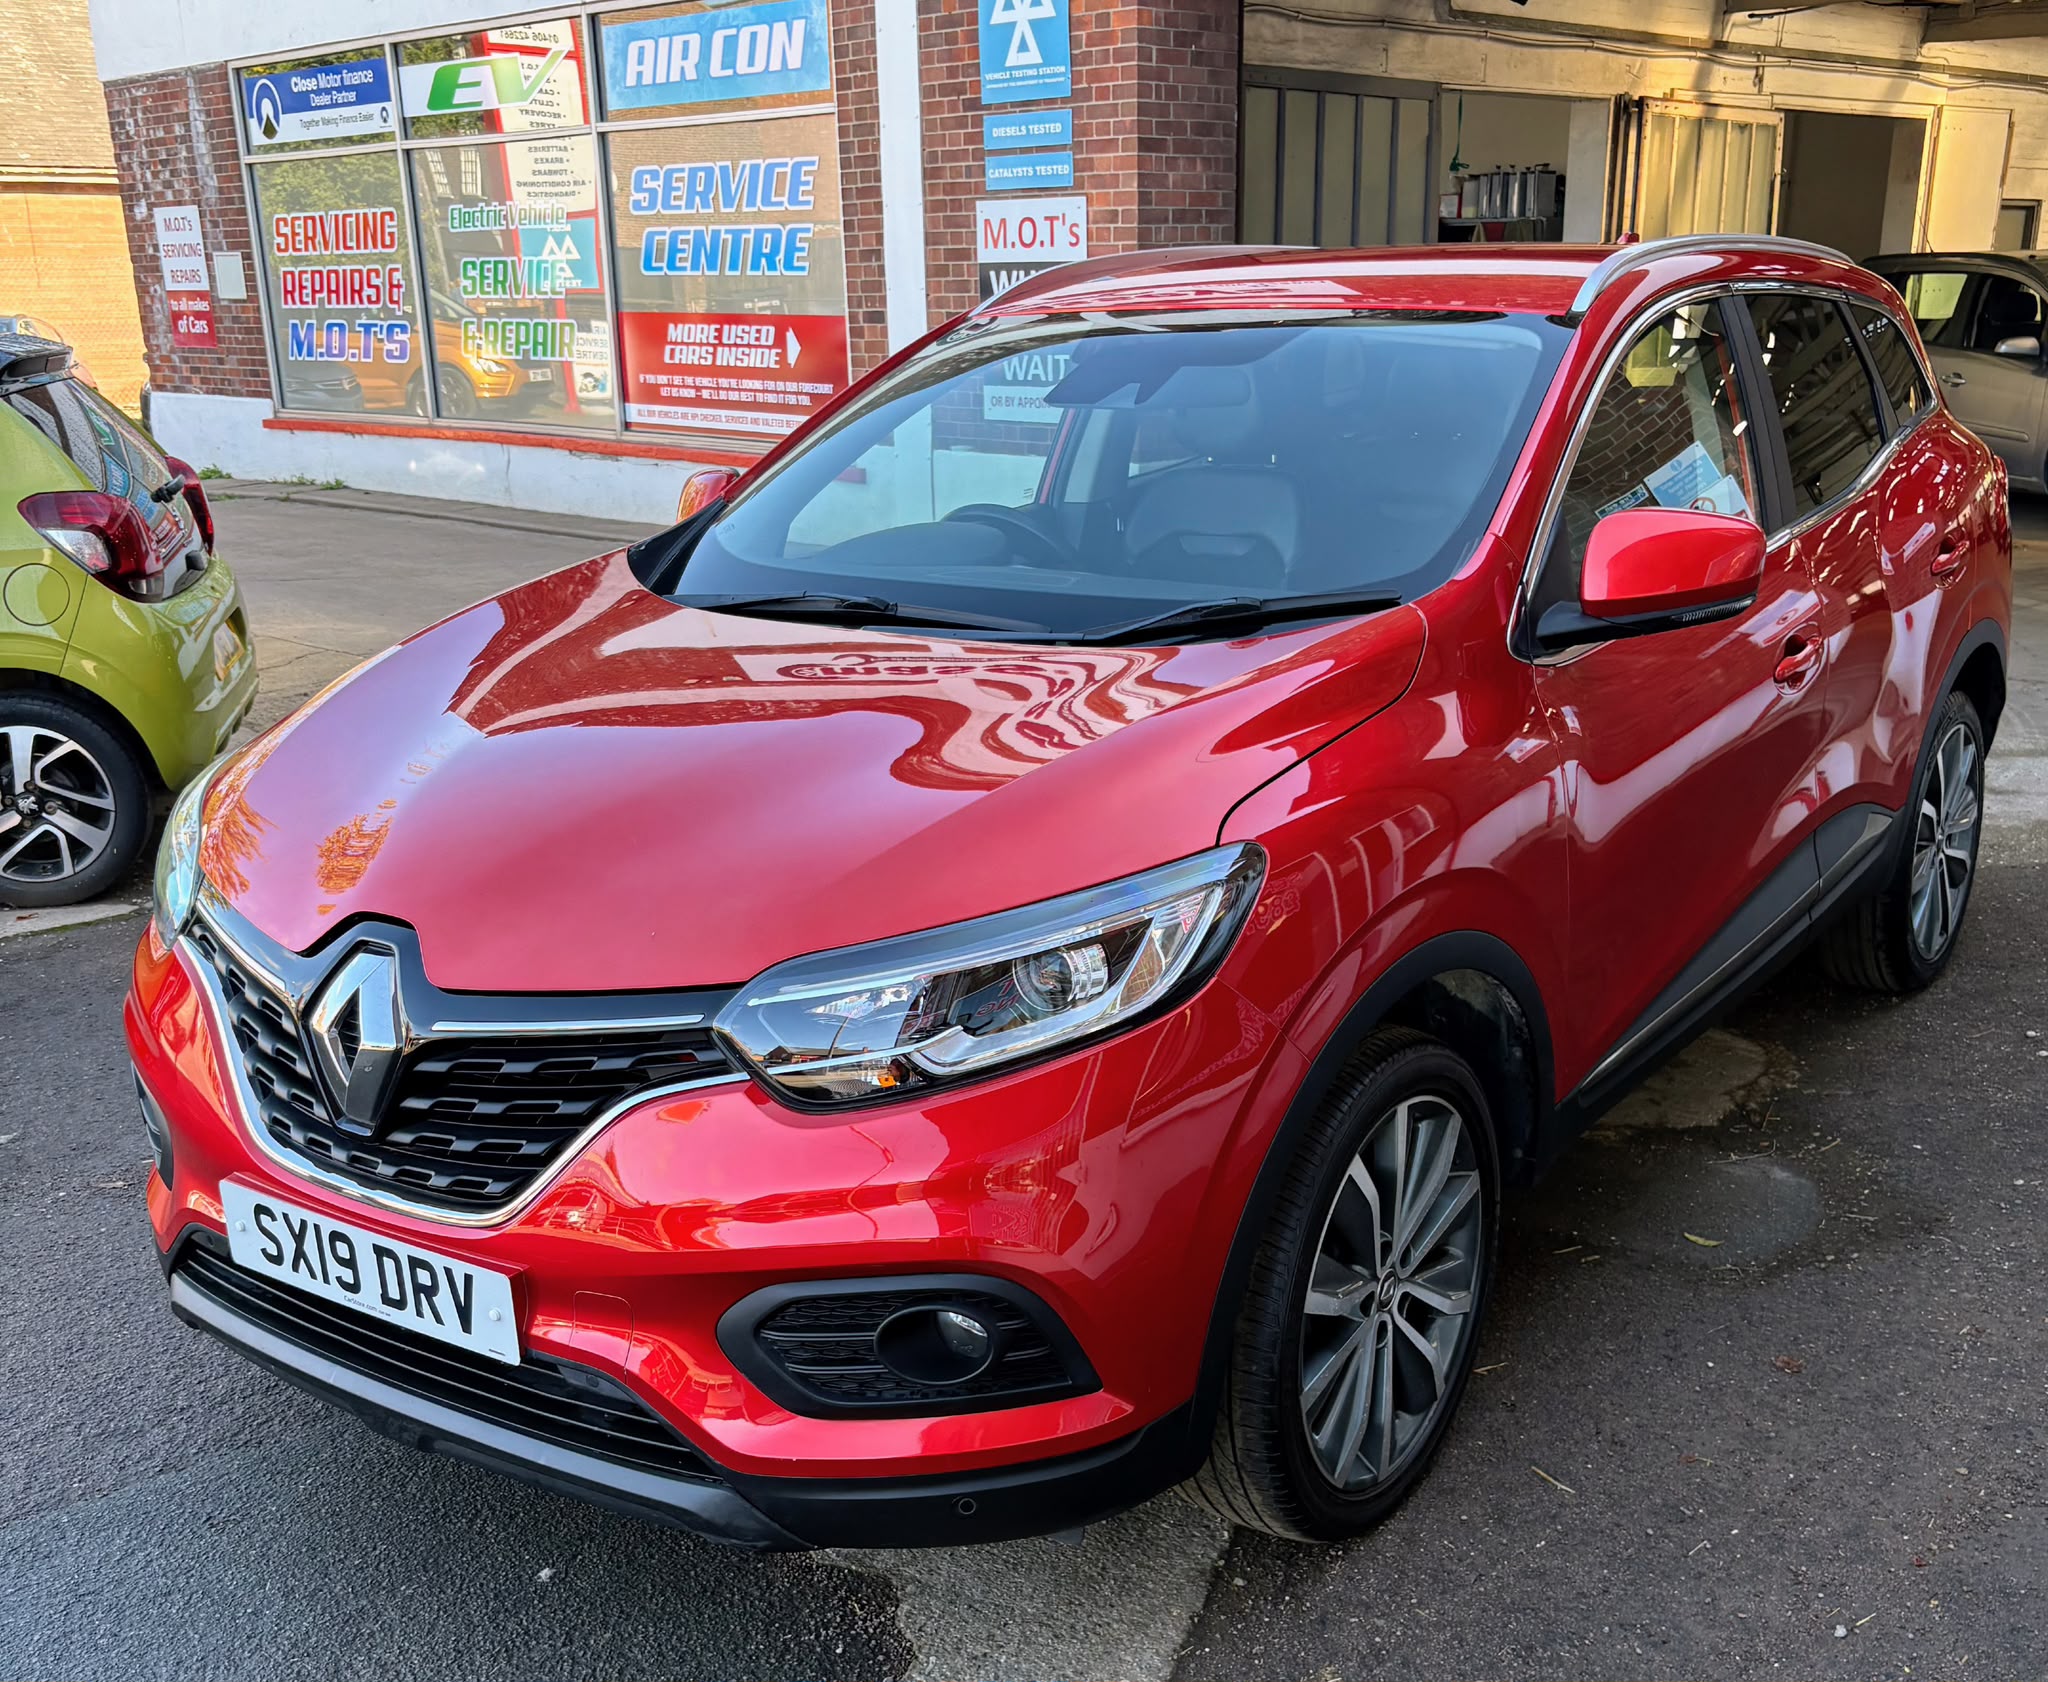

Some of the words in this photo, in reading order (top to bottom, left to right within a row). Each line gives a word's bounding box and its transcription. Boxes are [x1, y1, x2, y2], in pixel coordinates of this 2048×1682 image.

[624, 33, 701, 88] AIR
[709, 18, 807, 78] CON
[291, 76, 317, 92] Close
[317, 72, 341, 88] Motor
[342, 69, 373, 85] finance
[427, 48, 567, 112] EV
[985, 70, 1010, 81] VEHICLE
[1012, 68, 1037, 79] TESTING
[1038, 65, 1066, 76] STATION
[310, 93, 331, 106] Dealer
[332, 91, 356, 104] Partner
[992, 125, 1026, 138] DIESELS
[1028, 123, 1062, 135] TESTED
[988, 166, 1033, 179] CATALYSTS
[1035, 164, 1070, 176] TESTED
[630, 156, 819, 215] SERVICE
[163, 216, 193, 232] M.O.T's
[449, 206, 507, 230] Electric
[507, 202, 567, 227] Vehicle
[275, 210, 396, 254] SERVICING
[983, 212, 1081, 250] M.O.T's
[162, 243, 202, 258] SERVICING
[640, 223, 813, 276] CENTRE
[170, 268, 202, 284] REPAIRS
[462, 259, 566, 298] SERVICE
[282, 268, 382, 307] REPAIRS
[387, 267, 403, 312] &
[171, 298, 178, 311] to
[179, 297, 187, 311] all
[188, 297, 210, 311] makes
[178, 315, 188, 333] of
[189, 315, 209, 334] Cars
[667, 323, 720, 345] MORE
[722, 324, 775, 346] USED
[290, 321, 410, 362] M.O.T'S
[463, 321, 483, 361] &
[485, 321, 576, 361] REPAIR
[664, 345, 713, 366] CARS
[715, 346, 782, 369] INSIDE
[1003, 354, 1070, 382] WAIT
[990, 396, 1003, 408] OR
[1004, 396, 1016, 408] BY
[252, 1203, 362, 1295] SX19
[372, 1243, 474, 1335] DRV
